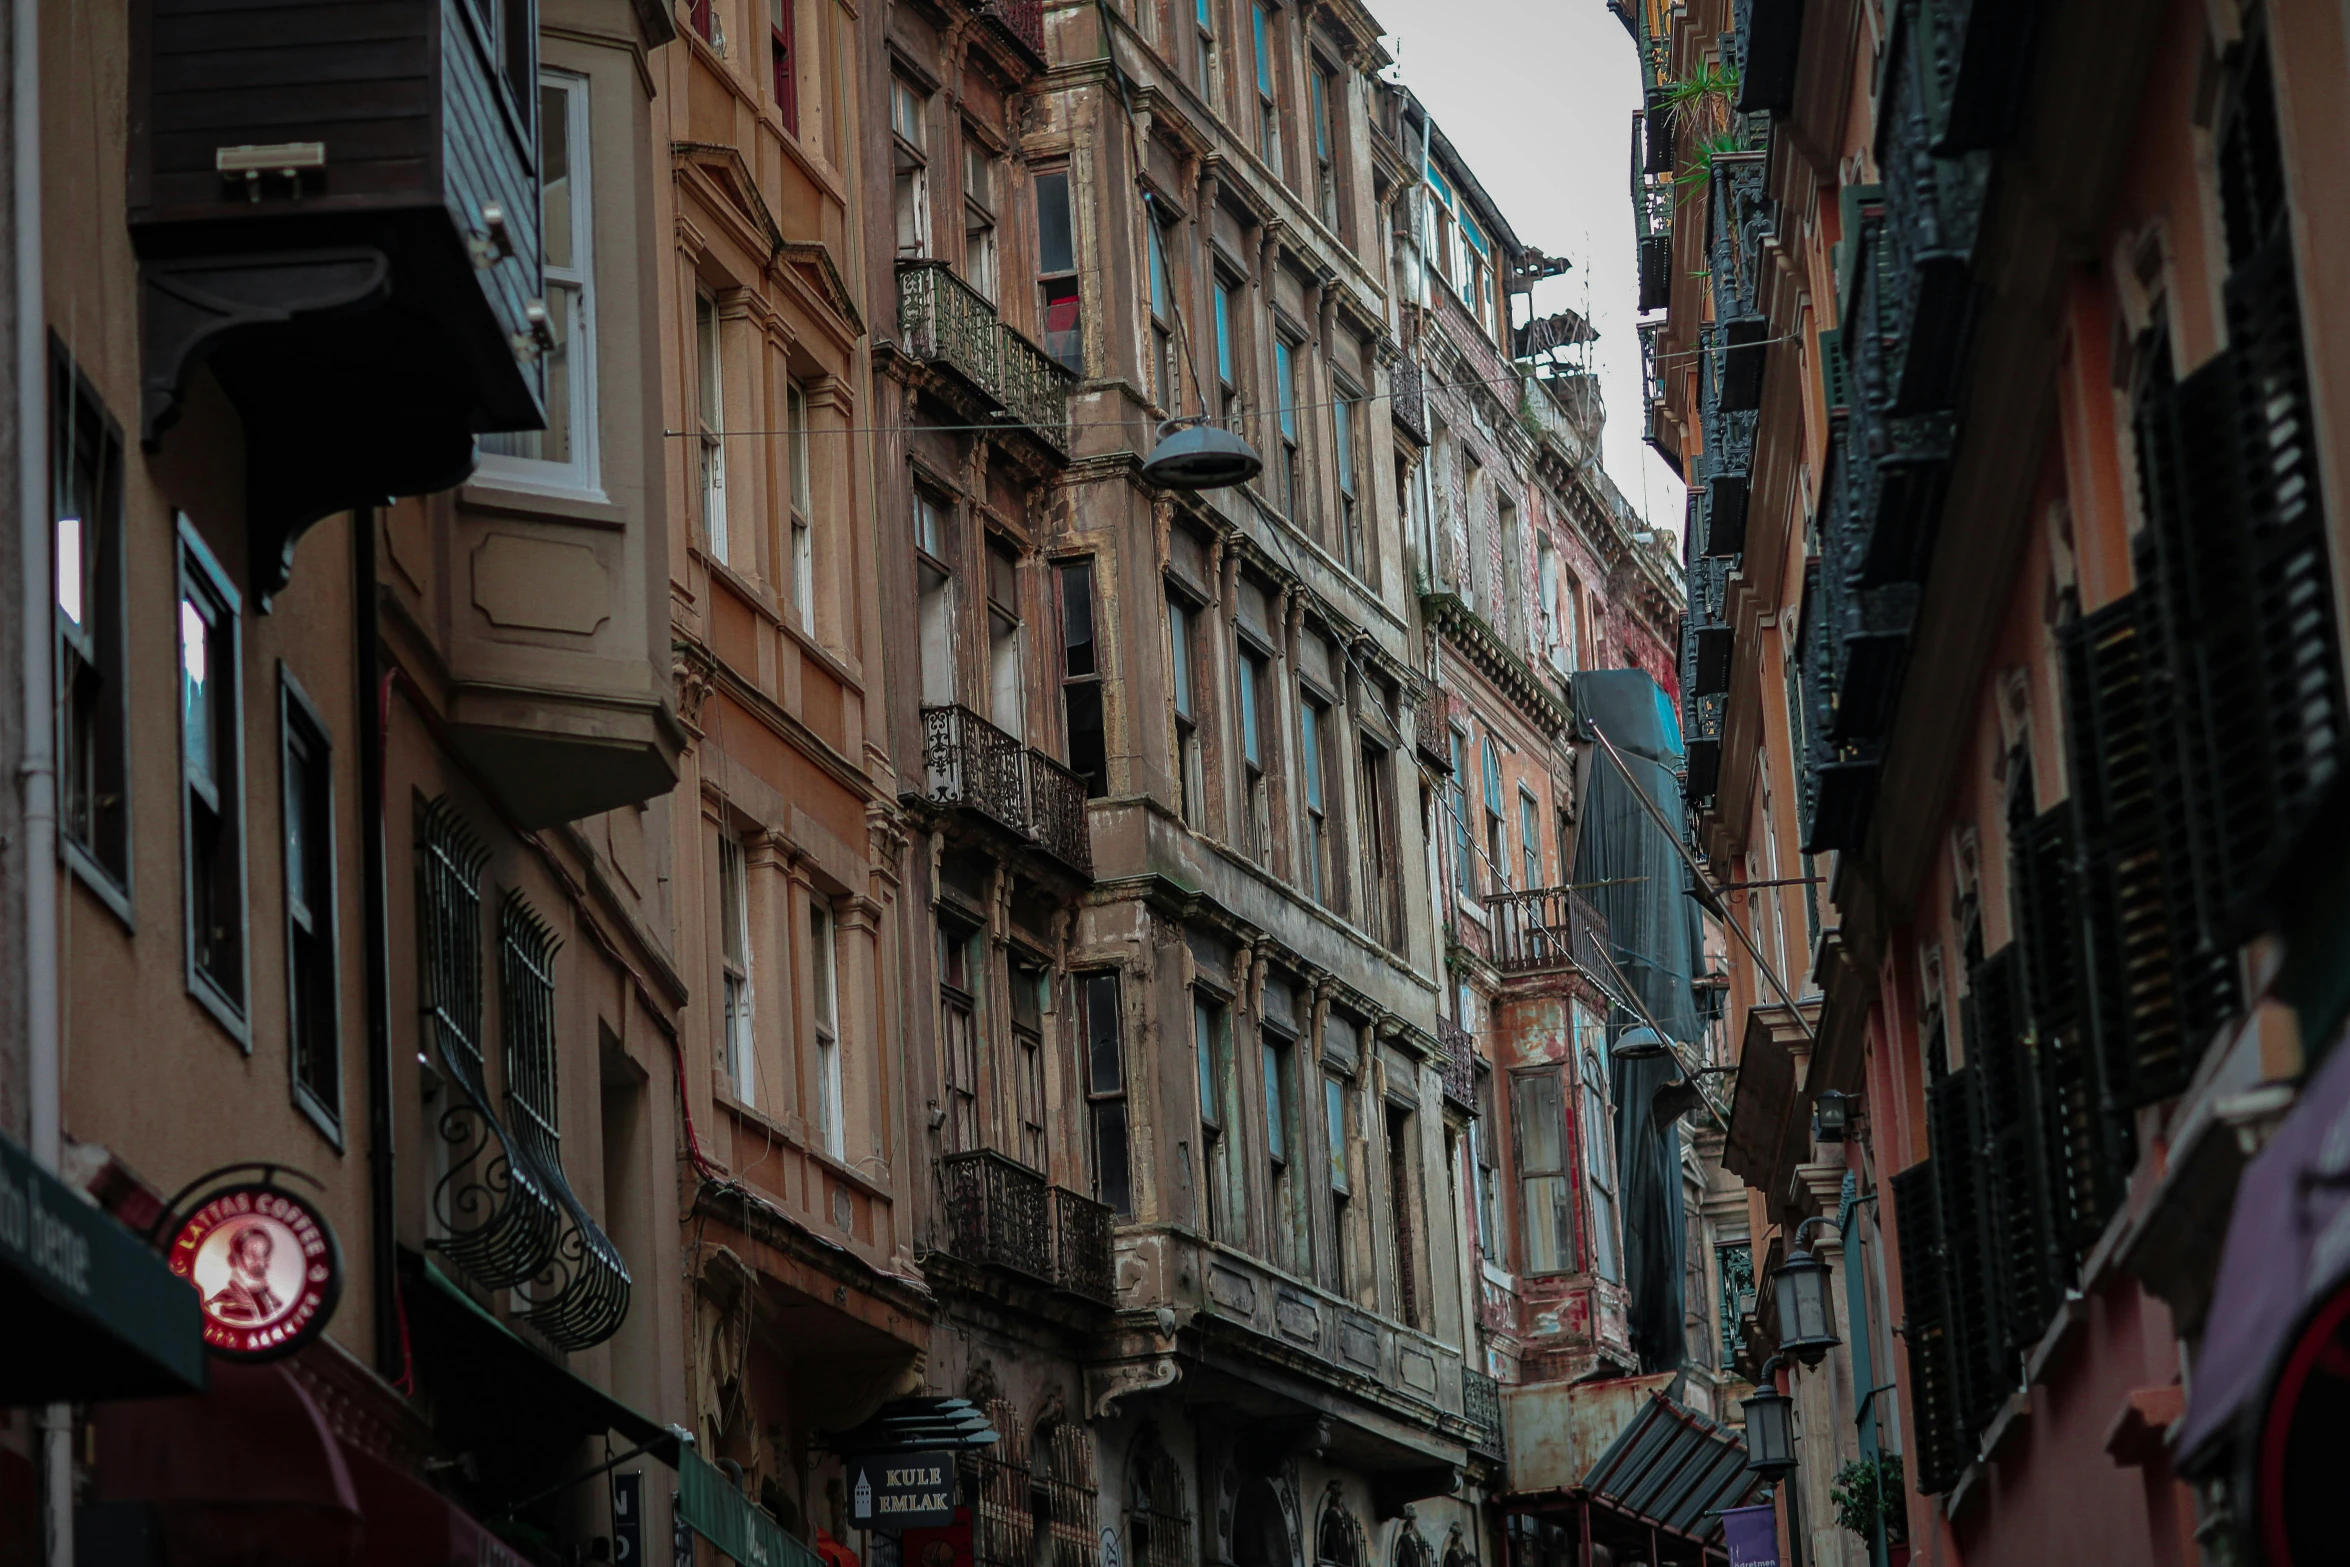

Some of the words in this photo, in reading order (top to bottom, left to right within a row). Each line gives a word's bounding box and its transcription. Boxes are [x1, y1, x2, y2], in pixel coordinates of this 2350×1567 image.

[255, 1192, 326, 1258] COFFEE
[886, 1467, 942, 1487] KULE
[879, 1493, 948, 1513] EMLAK
